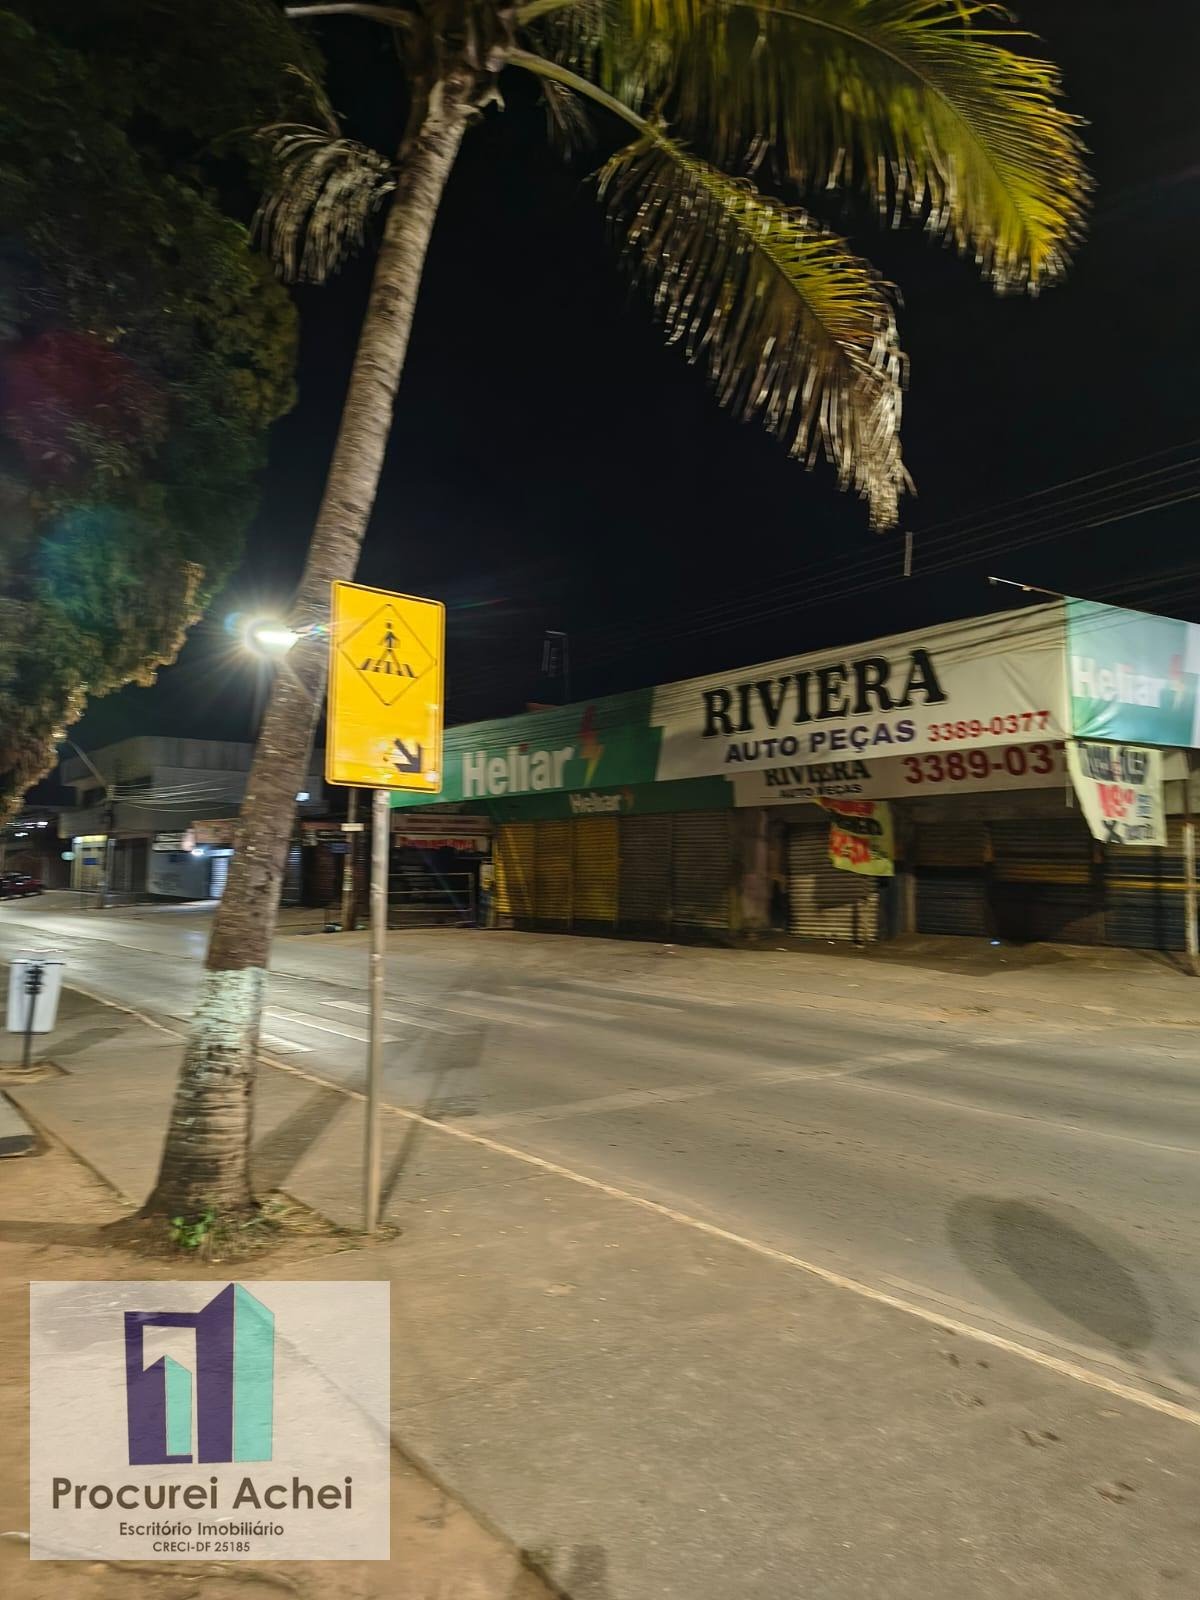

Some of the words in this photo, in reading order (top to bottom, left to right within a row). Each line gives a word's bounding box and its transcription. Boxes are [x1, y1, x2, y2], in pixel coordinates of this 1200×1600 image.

[702, 647, 948, 738] RIVIERA
[1073, 655, 1166, 708] Heliar
[725, 736, 799, 763] AUTO
[809, 720, 916, 753] PEÇAS
[927, 710, 1051, 742] 3389-0377
[462, 743, 575, 798] Heliar
